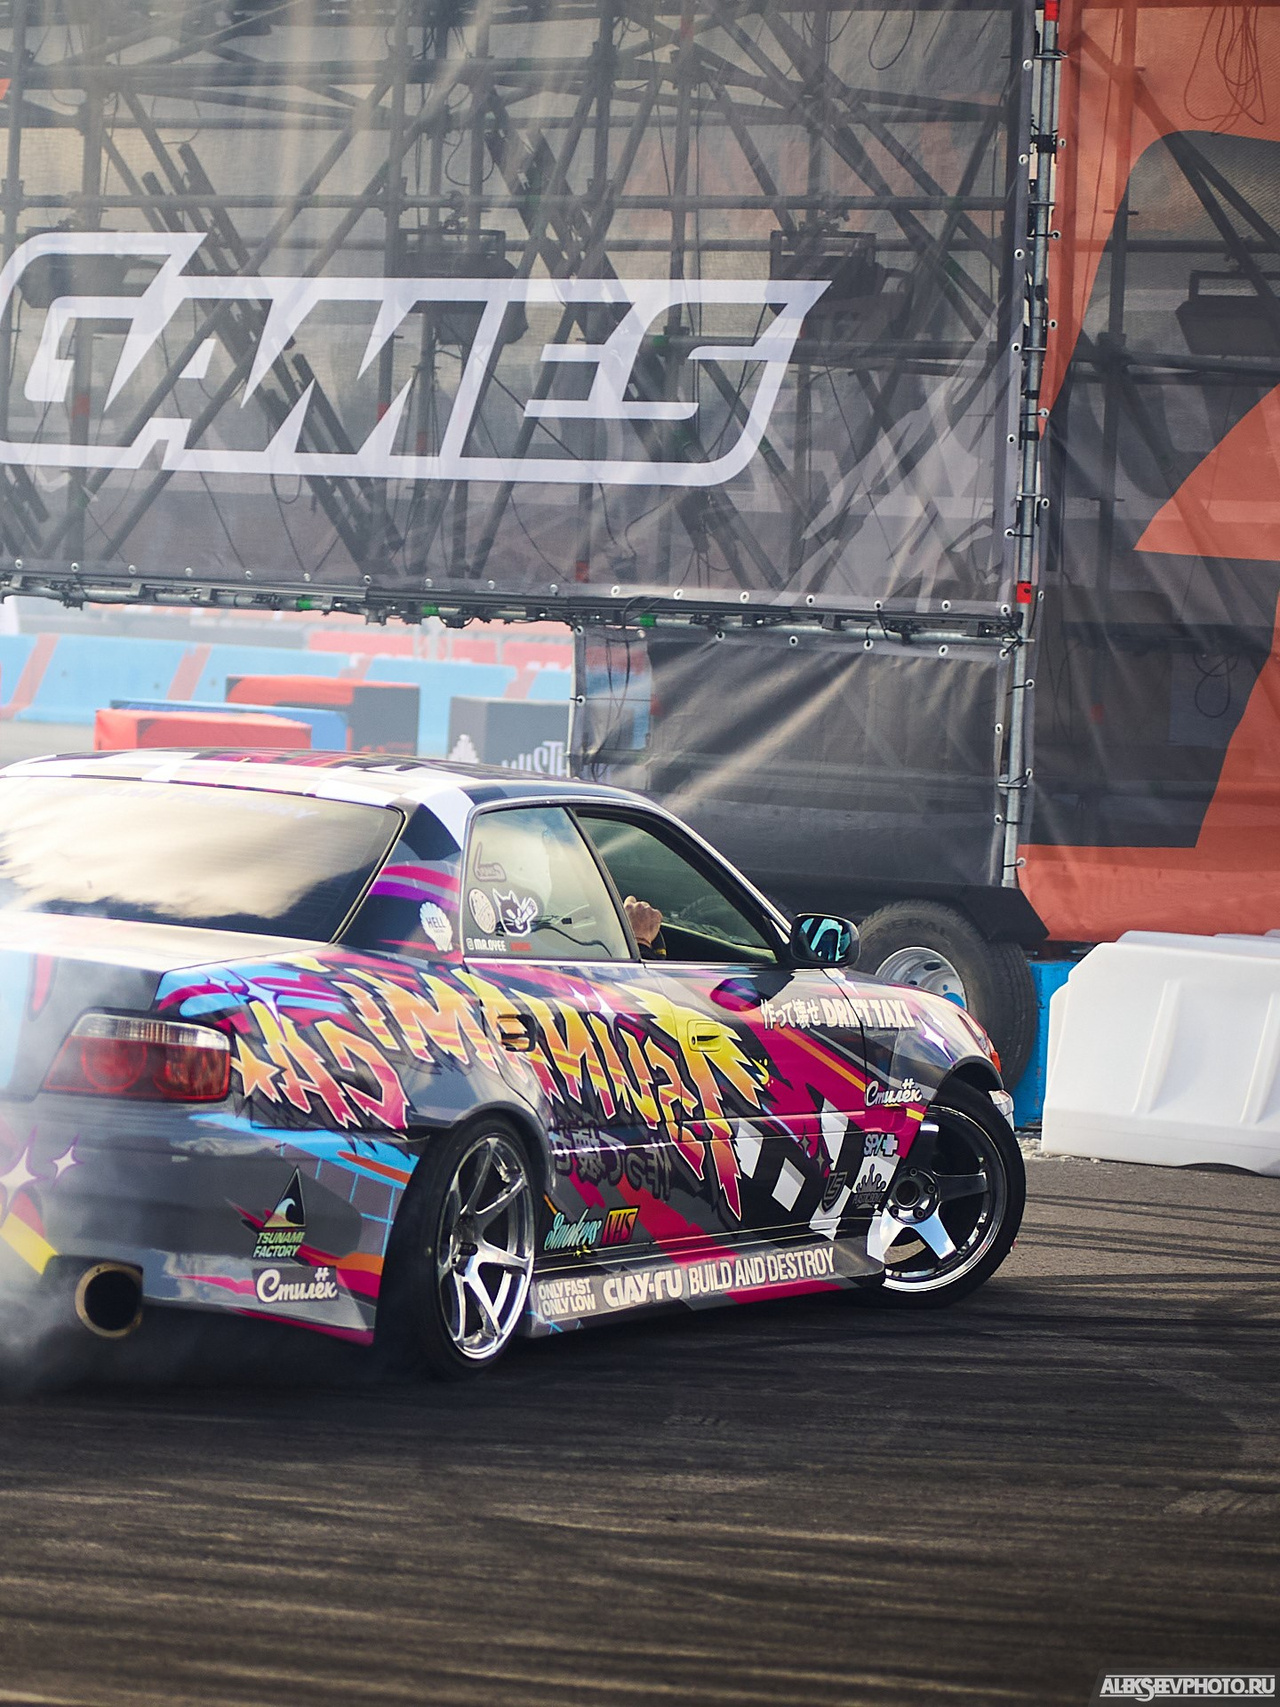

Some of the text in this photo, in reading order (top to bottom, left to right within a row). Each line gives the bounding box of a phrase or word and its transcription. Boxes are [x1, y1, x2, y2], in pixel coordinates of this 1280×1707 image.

[820, 998, 916, 1028] DRIFT TAXI
[257, 1231, 306, 1244] TSUNAMI
[604, 1210, 637, 1243] VHS
[253, 1245, 300, 1258] FACTORY
[688, 1261, 733, 1296] BUILD
[735, 1257, 767, 1287] AND
[768, 1247, 835, 1282] DESTROY
[538, 1278, 591, 1300] ONLY FAST
[542, 1294, 596, 1316] ONLY LOW
